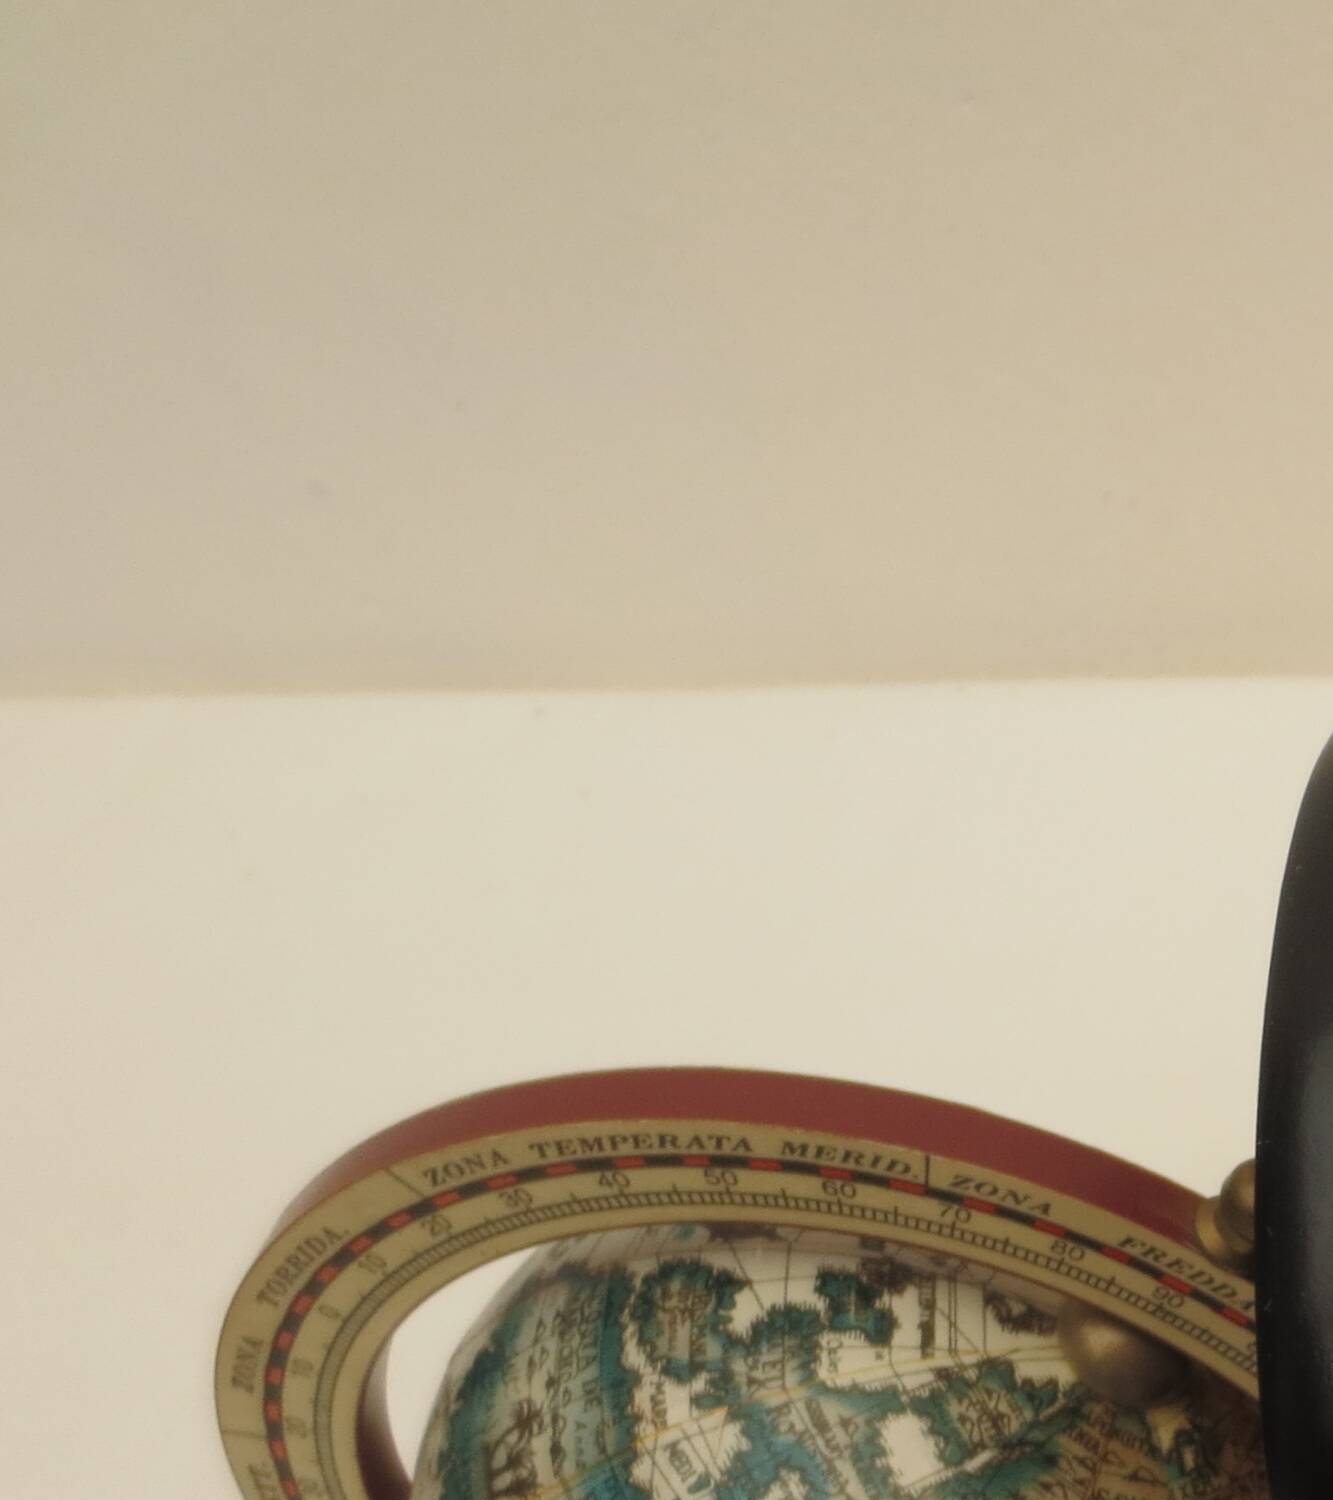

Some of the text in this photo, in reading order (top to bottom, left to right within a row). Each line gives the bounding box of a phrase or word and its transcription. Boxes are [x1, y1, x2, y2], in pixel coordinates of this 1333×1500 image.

[422, 1132, 922, 1190] ZONA TEMPERATA MERID.
[597, 1170, 631, 1192] 40
[704, 1168, 739, 1188] 50
[821, 1179, 856, 1200] 60
[500, 1186, 534, 1209] 30
[949, 1173, 1053, 1219] ZONA
[938, 1203, 972, 1224] 70
[421, 1213, 453, 1238] 20
[1049, 1237, 1087, 1263] 80
